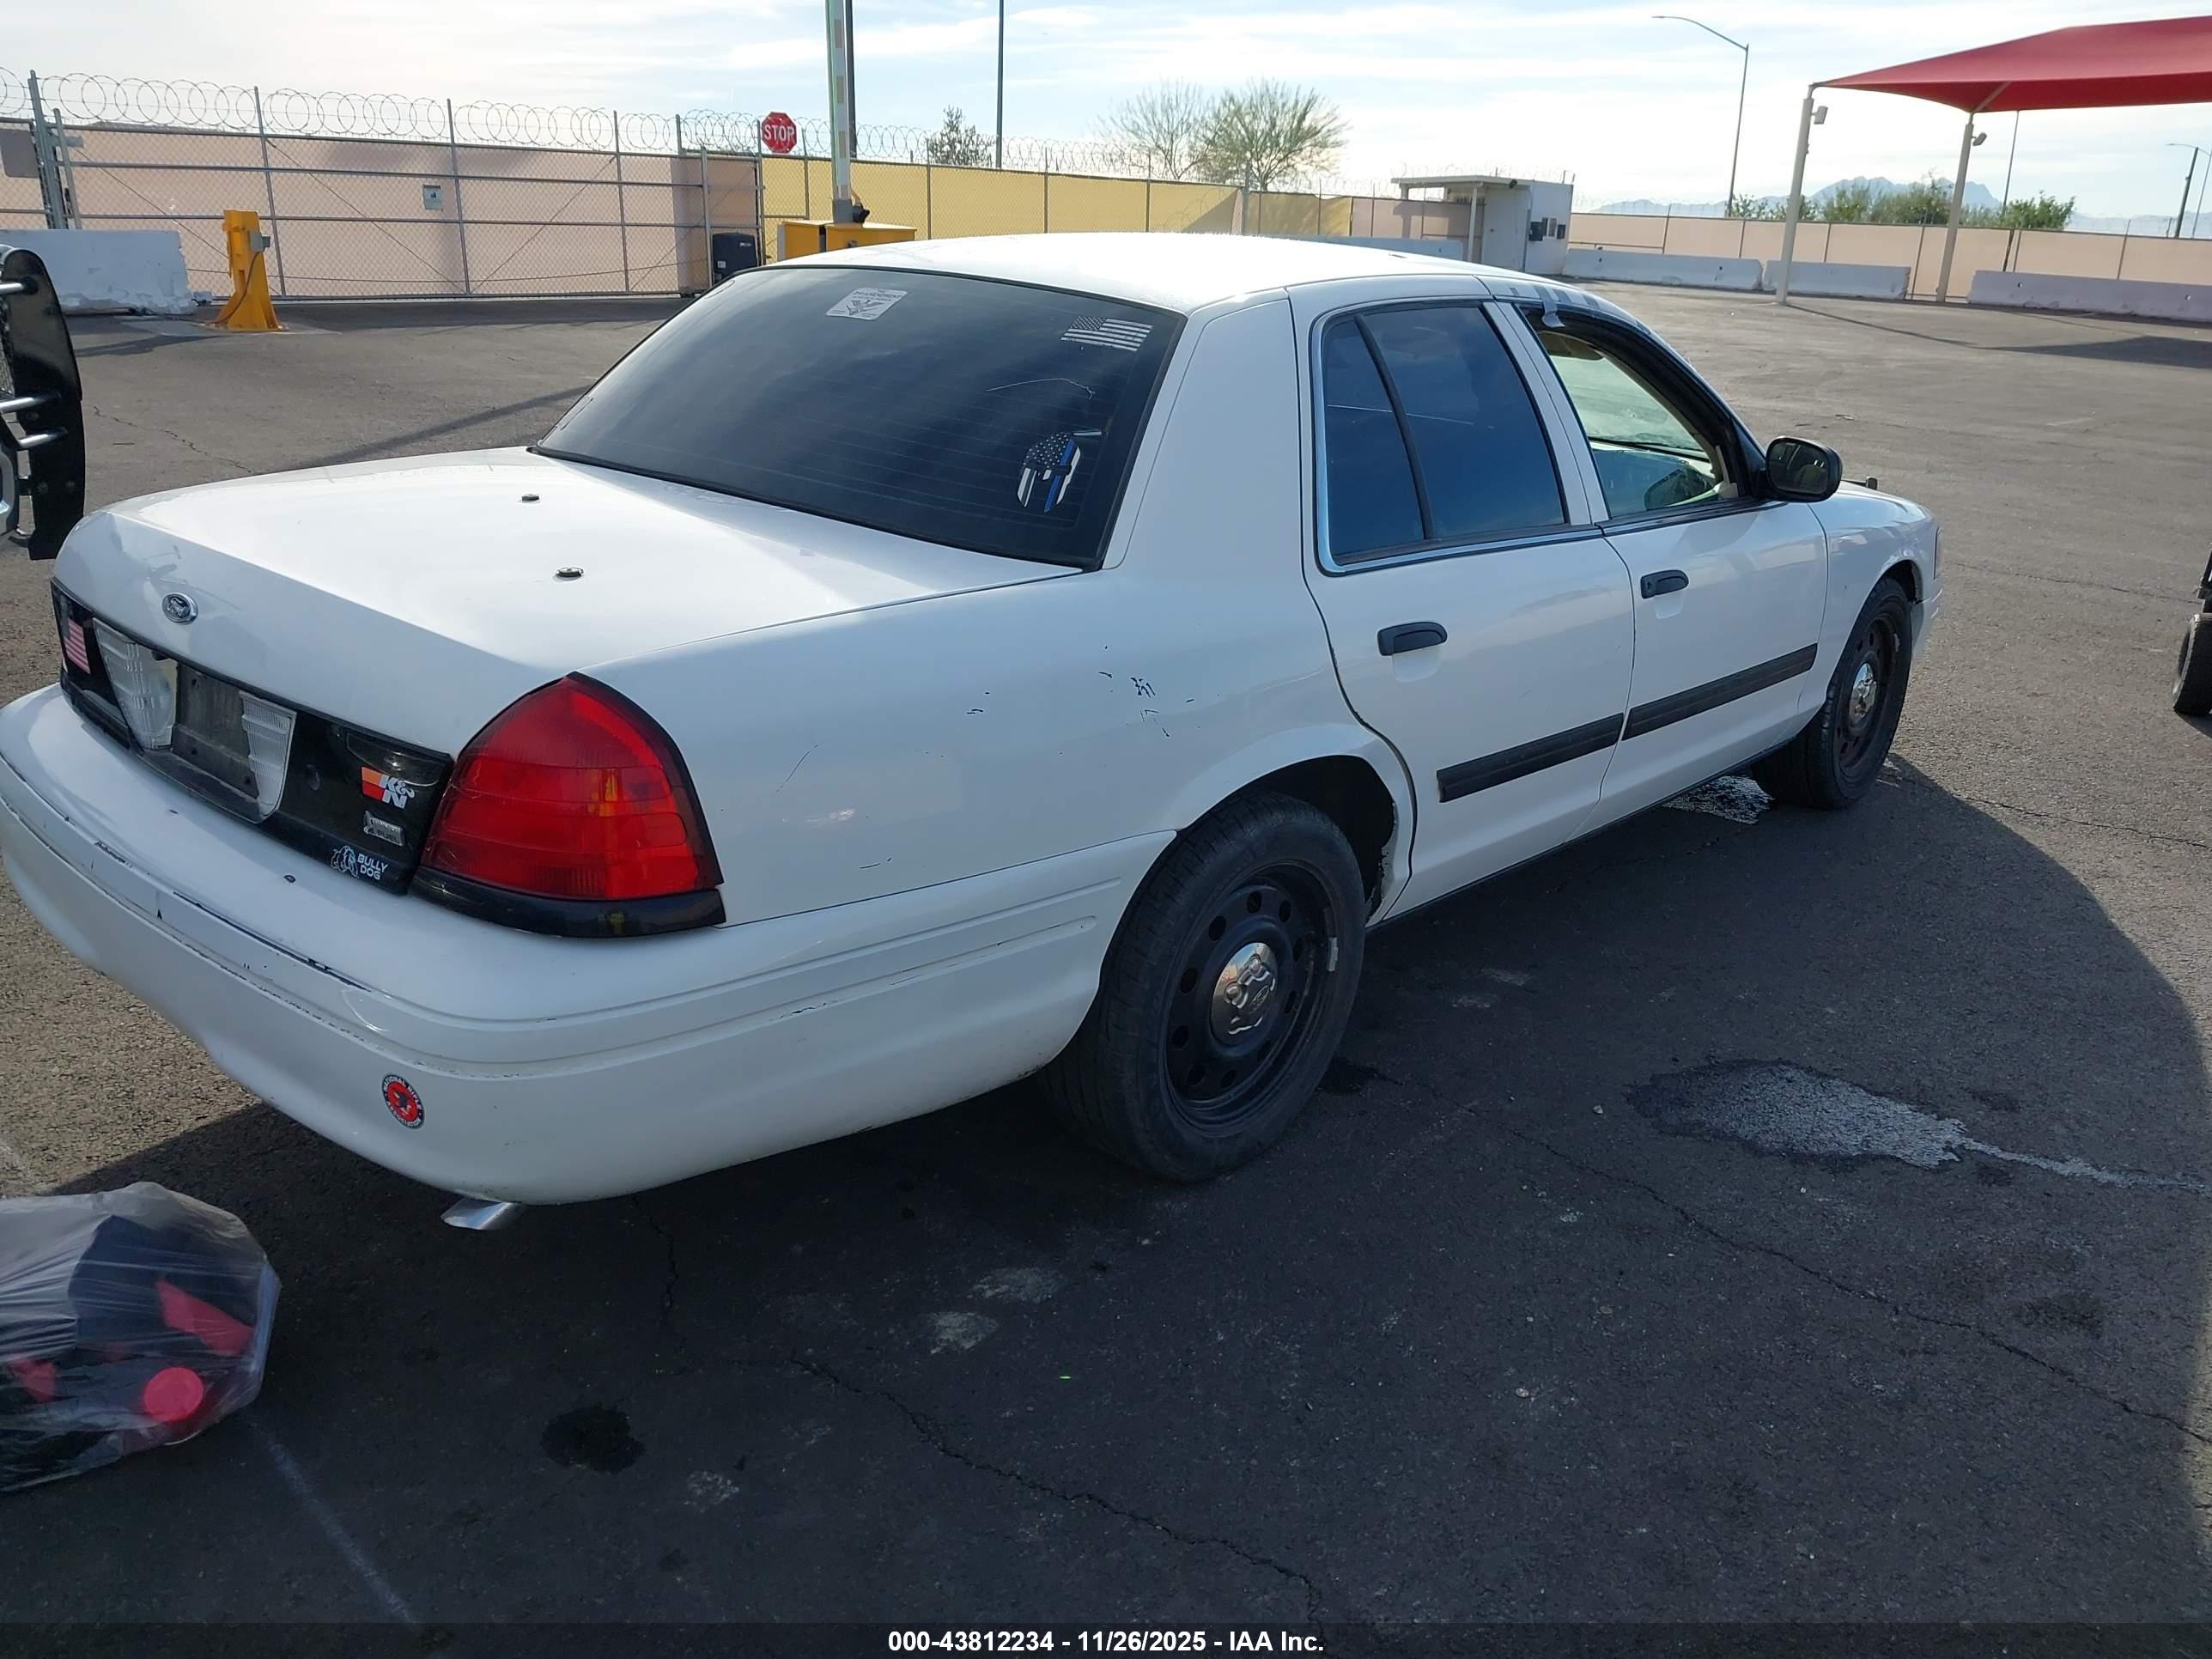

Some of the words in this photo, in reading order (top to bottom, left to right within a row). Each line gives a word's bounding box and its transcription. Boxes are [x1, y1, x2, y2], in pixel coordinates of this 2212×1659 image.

[764, 124, 794, 143] STOP
[357, 854, 388, 872] BULLY
[360, 864, 380, 880] DOG
